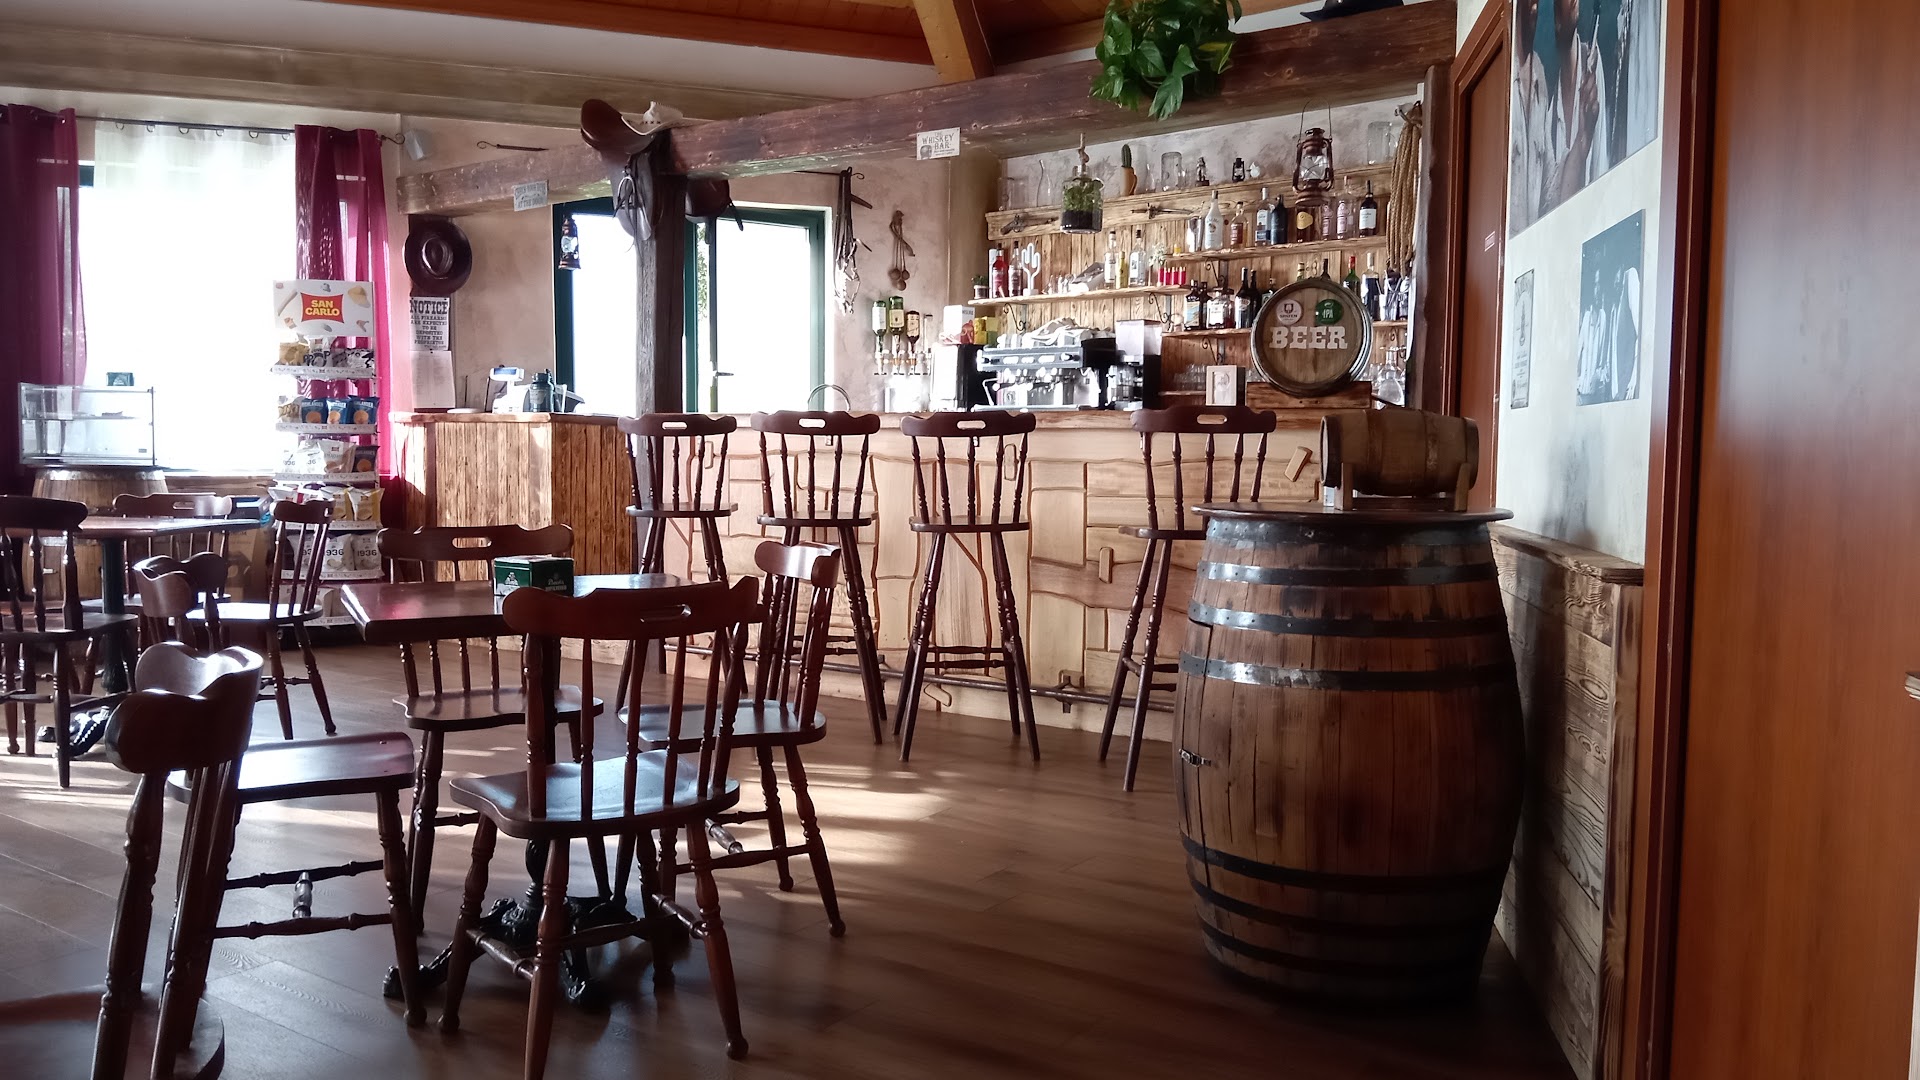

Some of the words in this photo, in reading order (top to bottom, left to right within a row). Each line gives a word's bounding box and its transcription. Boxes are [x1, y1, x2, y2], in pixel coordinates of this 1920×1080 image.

[922, 133, 954, 145] WHISKEY
[934, 142, 950, 150] BAR
[311, 299, 333, 308] SAN
[409, 299, 448, 315] NOTICE
[305, 307, 340, 316] CARLO
[1322, 309, 1334, 319] IPA
[1269, 325, 1348, 350] BEER
[325, 548, 345, 556] 936
[357, 549, 377, 557] 1936
